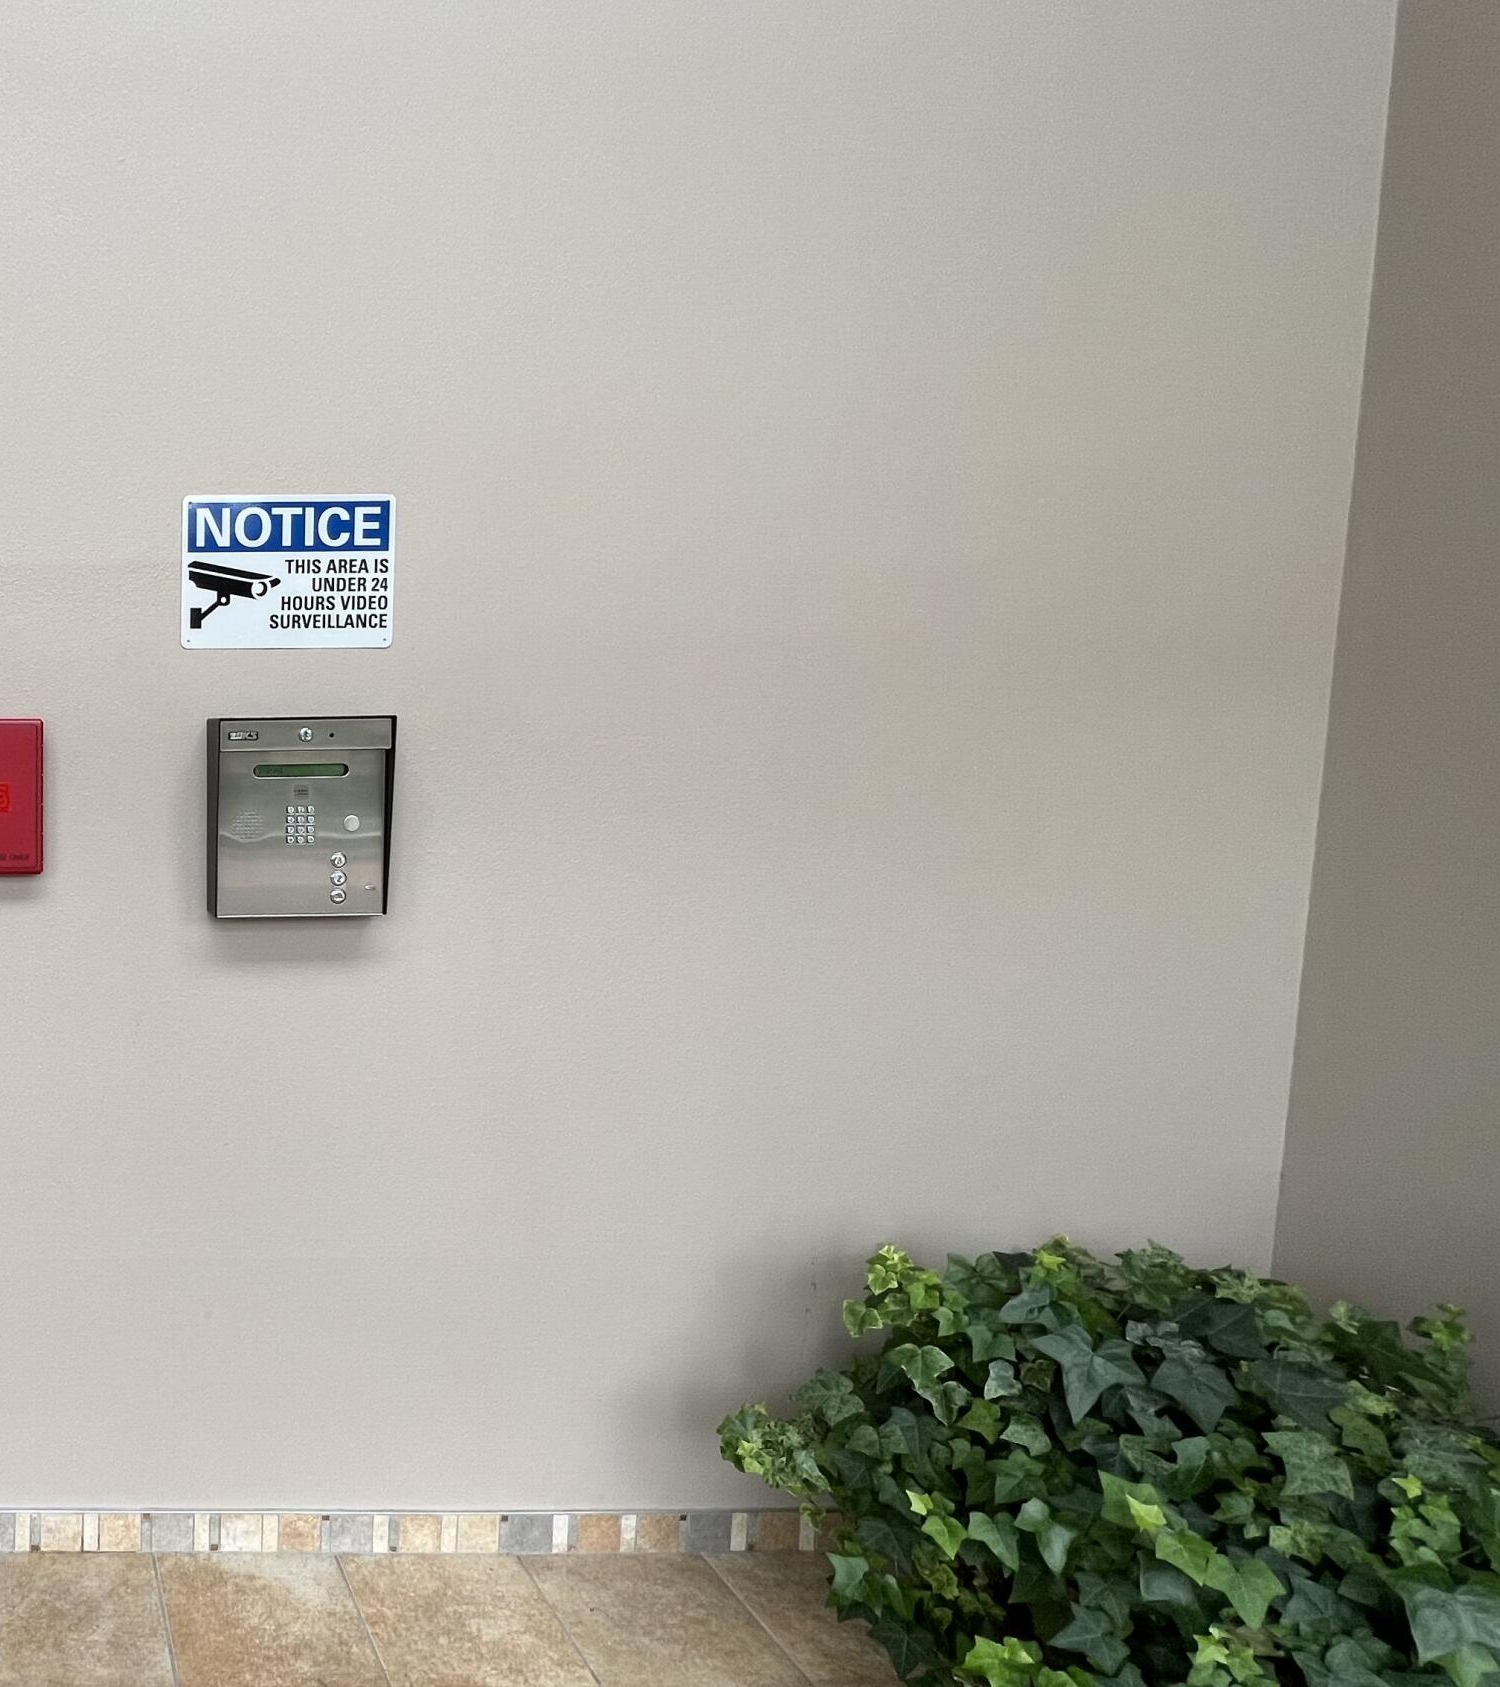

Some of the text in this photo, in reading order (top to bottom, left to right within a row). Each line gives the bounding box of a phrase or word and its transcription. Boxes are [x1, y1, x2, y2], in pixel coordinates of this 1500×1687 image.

[195, 506, 382, 548] NOTICE
[285, 558, 389, 574] THIS AREA IS
[312, 577, 389, 592] UNDER 24
[281, 595, 388, 611] HOURS VIDEO
[269, 613, 388, 629] SURVEILLANCE
